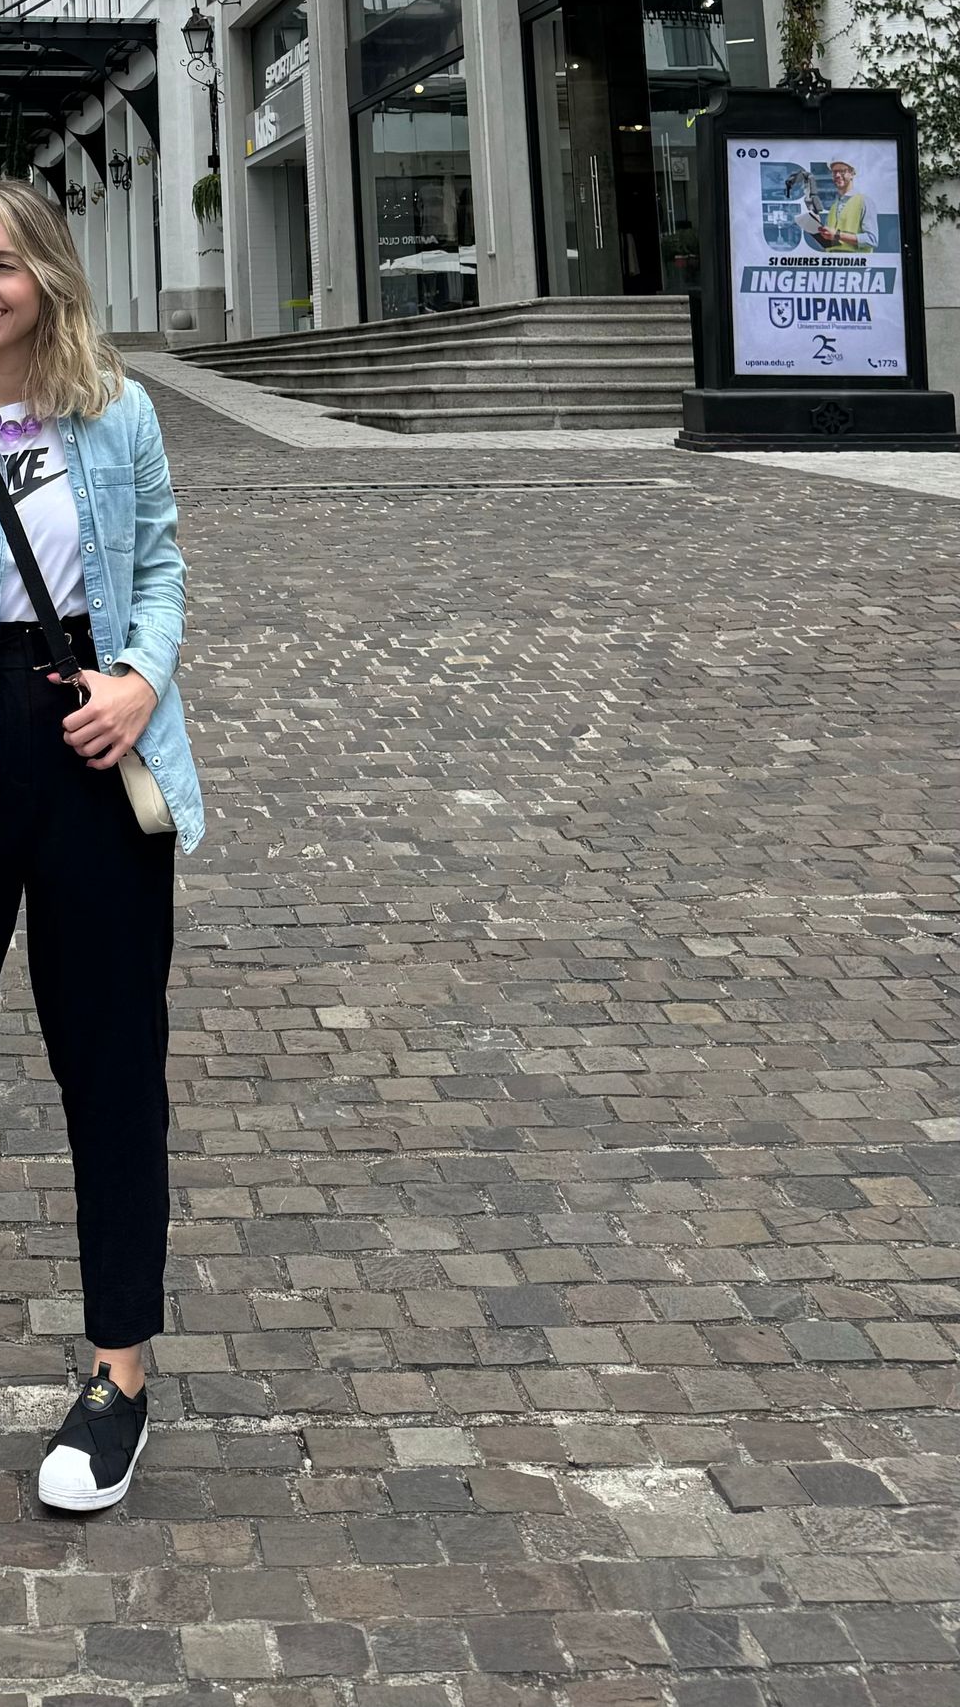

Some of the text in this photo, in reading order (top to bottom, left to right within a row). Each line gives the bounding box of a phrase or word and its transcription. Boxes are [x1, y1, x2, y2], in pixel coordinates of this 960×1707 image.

[265, 36, 310, 90] SPORTLINE
[769, 257, 867, 267] SI QUIERES ESTUDIAR
[750, 268, 887, 293] INGENIERÍA
[797, 297, 872, 322] UPANA
[812, 334, 837, 365] 25
[745, 359, 795, 369] upana.edu.gt
[878, 360, 898, 368] 1779
[2, 447, 50, 491] KE
